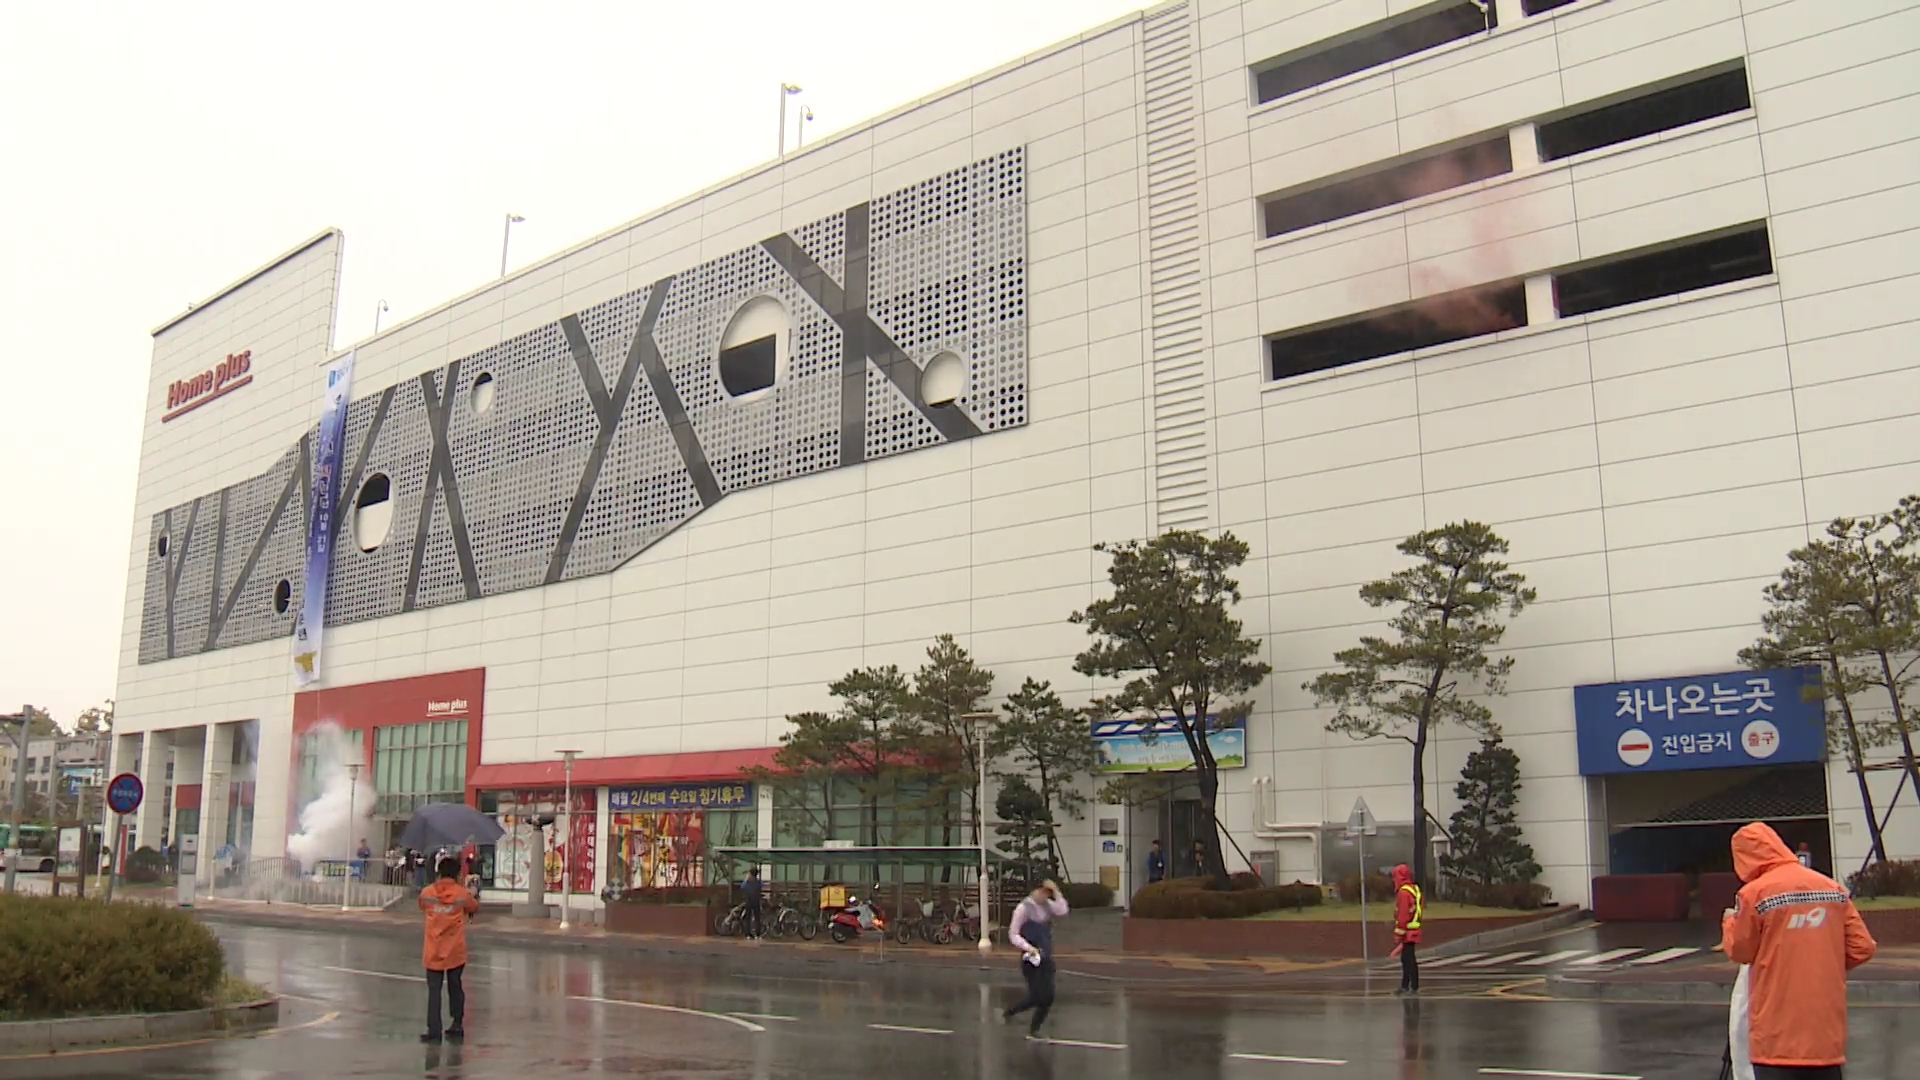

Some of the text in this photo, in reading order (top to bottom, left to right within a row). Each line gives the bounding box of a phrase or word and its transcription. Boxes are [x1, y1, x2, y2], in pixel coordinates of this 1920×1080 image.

[167, 350, 251, 409] Home plus
[428, 698, 468, 713] Home plus
[1615, 678, 1775, 723] 차나오는곳
[1661, 730, 1775, 755] 진입금지 출구
[611, 791, 629, 805] 매월
[669, 788, 697, 804] 수요일
[699, 785, 746, 805] 정기휴무
[1786, 906, 1827, 930] 119
